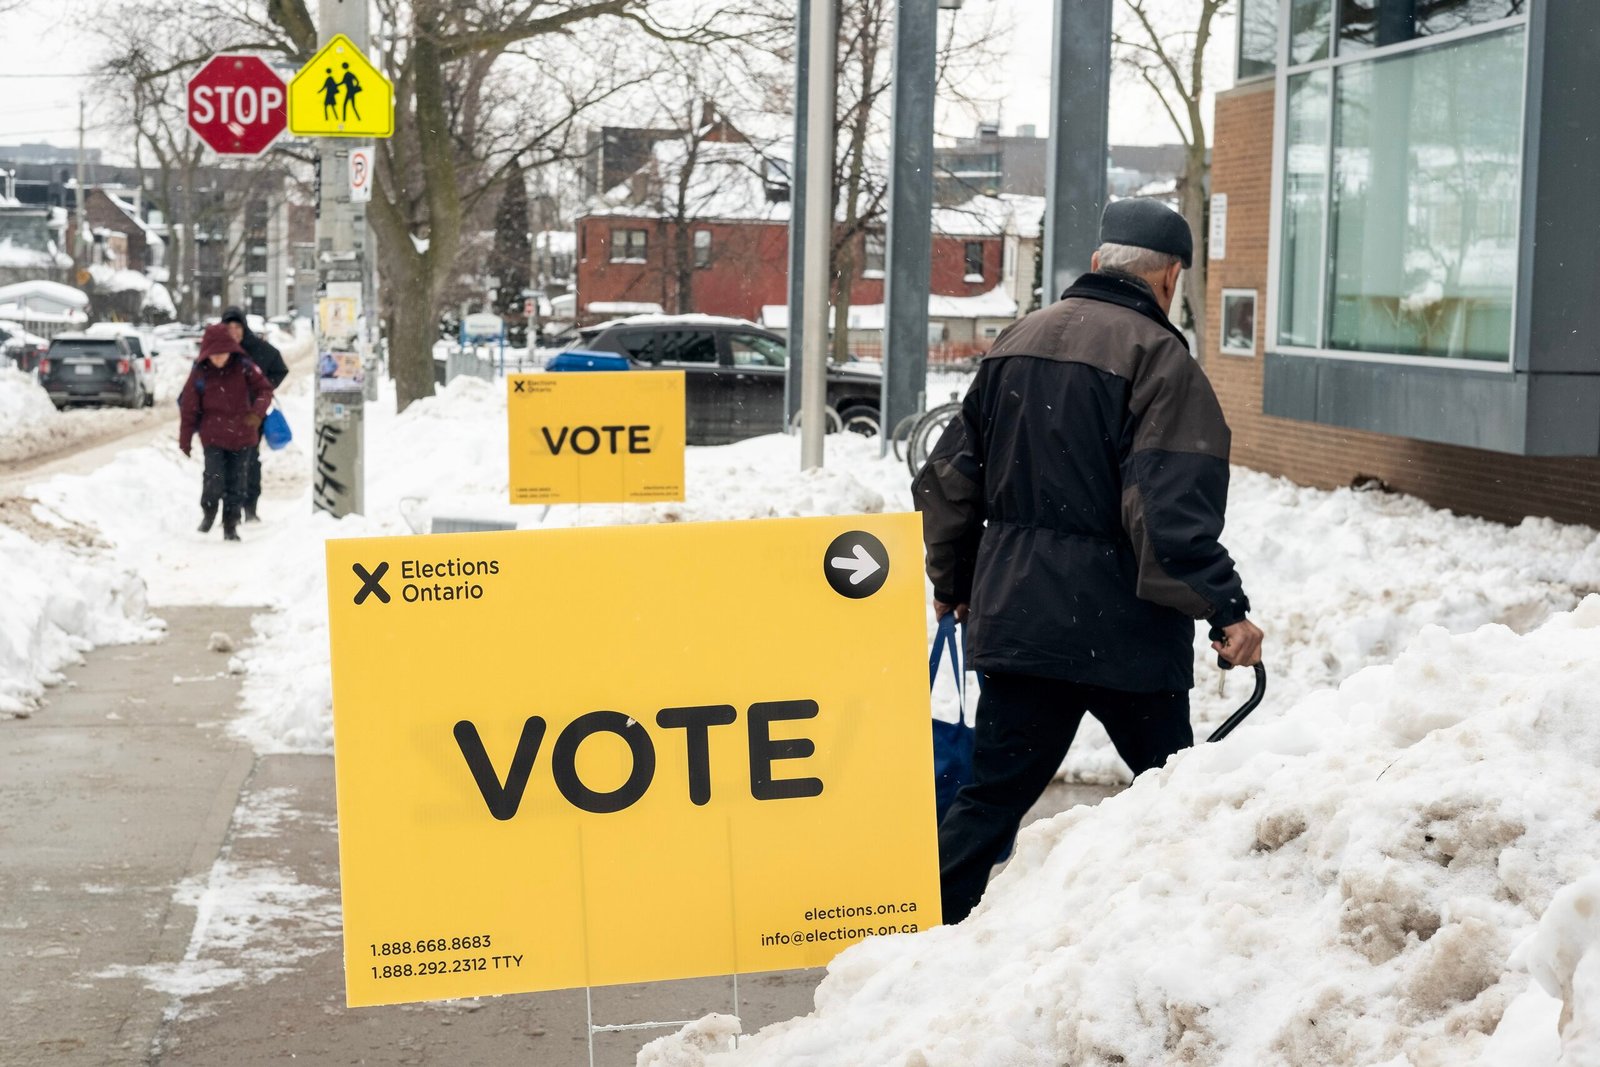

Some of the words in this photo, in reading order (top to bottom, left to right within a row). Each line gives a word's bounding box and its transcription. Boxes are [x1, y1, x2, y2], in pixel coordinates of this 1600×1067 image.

[192, 85, 283, 125] STOP
[541, 425, 651, 456] VOTE
[401, 558, 500, 579] Elections
[402, 581, 484, 603] Ontario
[453, 699, 824, 821] VOTE
[804, 902, 917, 921] elections.on.ca
[370, 935, 491, 957] 1.888.668.8683
[761, 923, 918, 947] info@elections.on.ca
[371, 957, 487, 979] 1.888.292.2312
[491, 954, 524, 969] TTY
